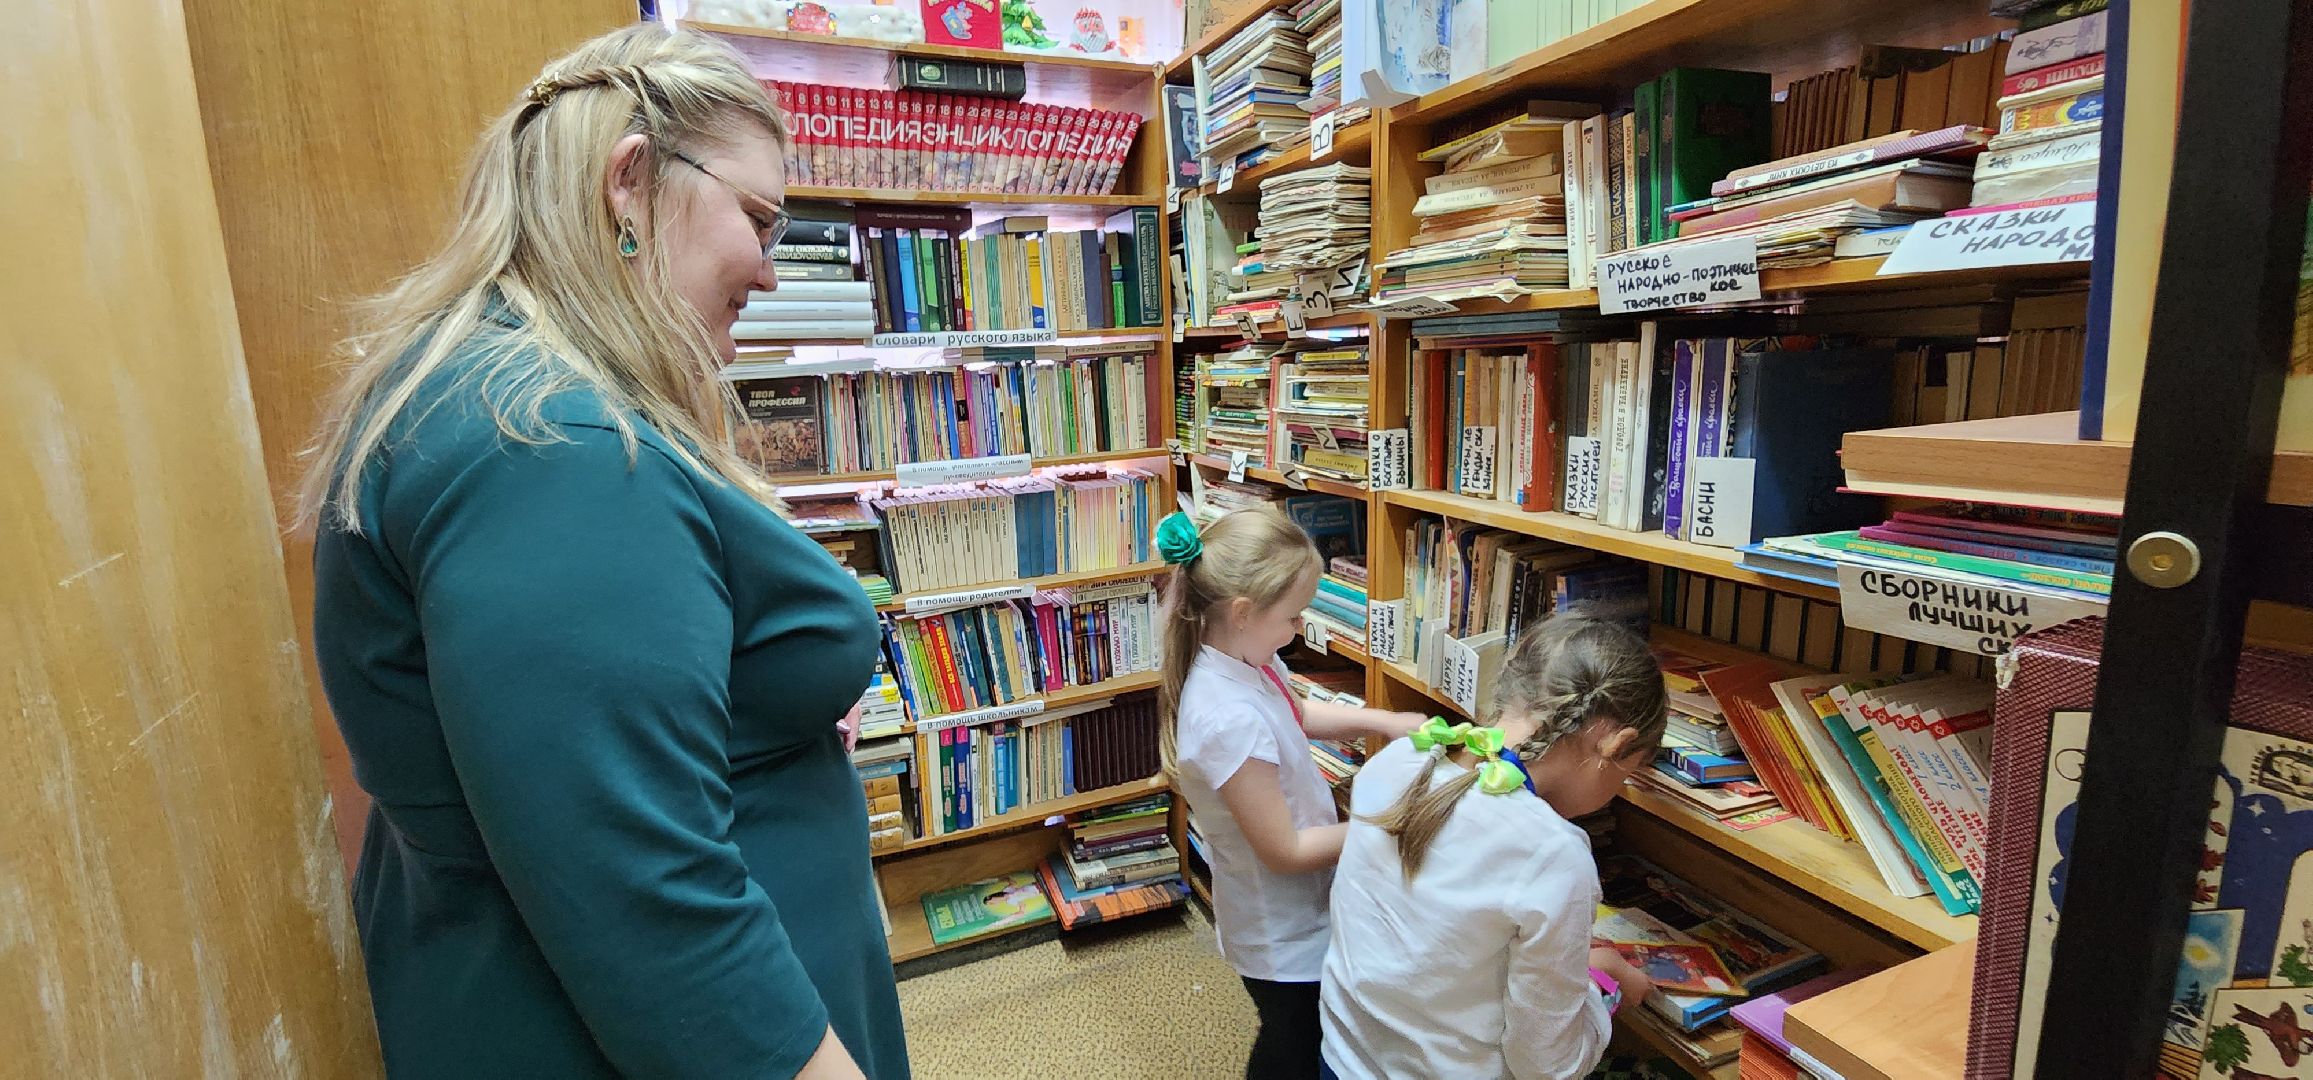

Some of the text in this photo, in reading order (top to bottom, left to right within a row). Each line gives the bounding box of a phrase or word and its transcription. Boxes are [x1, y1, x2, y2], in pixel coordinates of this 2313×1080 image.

[784, 91, 791, 103] 7
[798, 93, 806, 105] 8
[813, 94, 821, 106] 9
[825, 95, 837, 107] 10
[840, 96, 850, 108] 11
[855, 97, 866, 109] 12
[869, 98, 880, 110] 13
[883, 99, 894, 111] 14
[898, 101, 908, 113] 15
[910, 102, 921, 114] 16
[925, 104, 935, 115] 17
[940, 105, 950, 116] 18
[954, 105, 964, 117] 19
[967, 106, 979, 118] 20
[981, 106, 991, 118] 21
[994, 108, 1005, 120] 22
[1006, 108, 1018, 121] 23
[1019, 110, 1031, 122] 24
[1088, 117, 1100, 129] 29
[1101, 119, 1112, 131] 30
[1114, 118, 1125, 130] 31
[1127, 120, 1139, 132] 32
[783, 112, 1133, 157] ЛОПЕДИЯ ЭНЦИКЛОПЕДИЯ
[1611, 166, 1621, 215] СКАЗКИ
[1566, 151, 1577, 247] РУССКИЕ СКАЗКИ
[1930, 208, 2066, 240] СКАЗКИ
[1607, 254, 1673, 280] РУССКОЕ
[1622, 292, 1707, 311] ТВОРЧЕСТВО
[875, 332, 1052, 347] словари русского языка
[748, 397, 807, 408] ПРОФЕССИЯ
[1395, 435, 1407, 486] БЫЛИНЫ
[1231, 460, 1245, 476] К
[1371, 446, 1381, 489] СКАЗКИ
[1588, 439, 1602, 509] ПИСАТЕЛЕЙ
[1566, 454, 1580, 510] СКАЗКИ
[1578, 448, 1590, 509] РУССКИХ
[1695, 481, 1716, 538] БАСНИ
[917, 588, 1023, 607] В помощь родителям
[1860, 570, 2030, 618] СБОРНИКИ
[1908, 602, 2033, 639] ЛУЧШИХ
[1305, 621, 1325, 649] Р
[927, 705, 1038, 730] В помощь школьникам
[1890, 744, 1939, 816] ЧЕЛОВЕКОМ!
[1949, 780, 1962, 793] 2
[1934, 797, 1968, 844] ЧТЕНИЕ
[1938, 816, 1963, 850] БУДЬ
